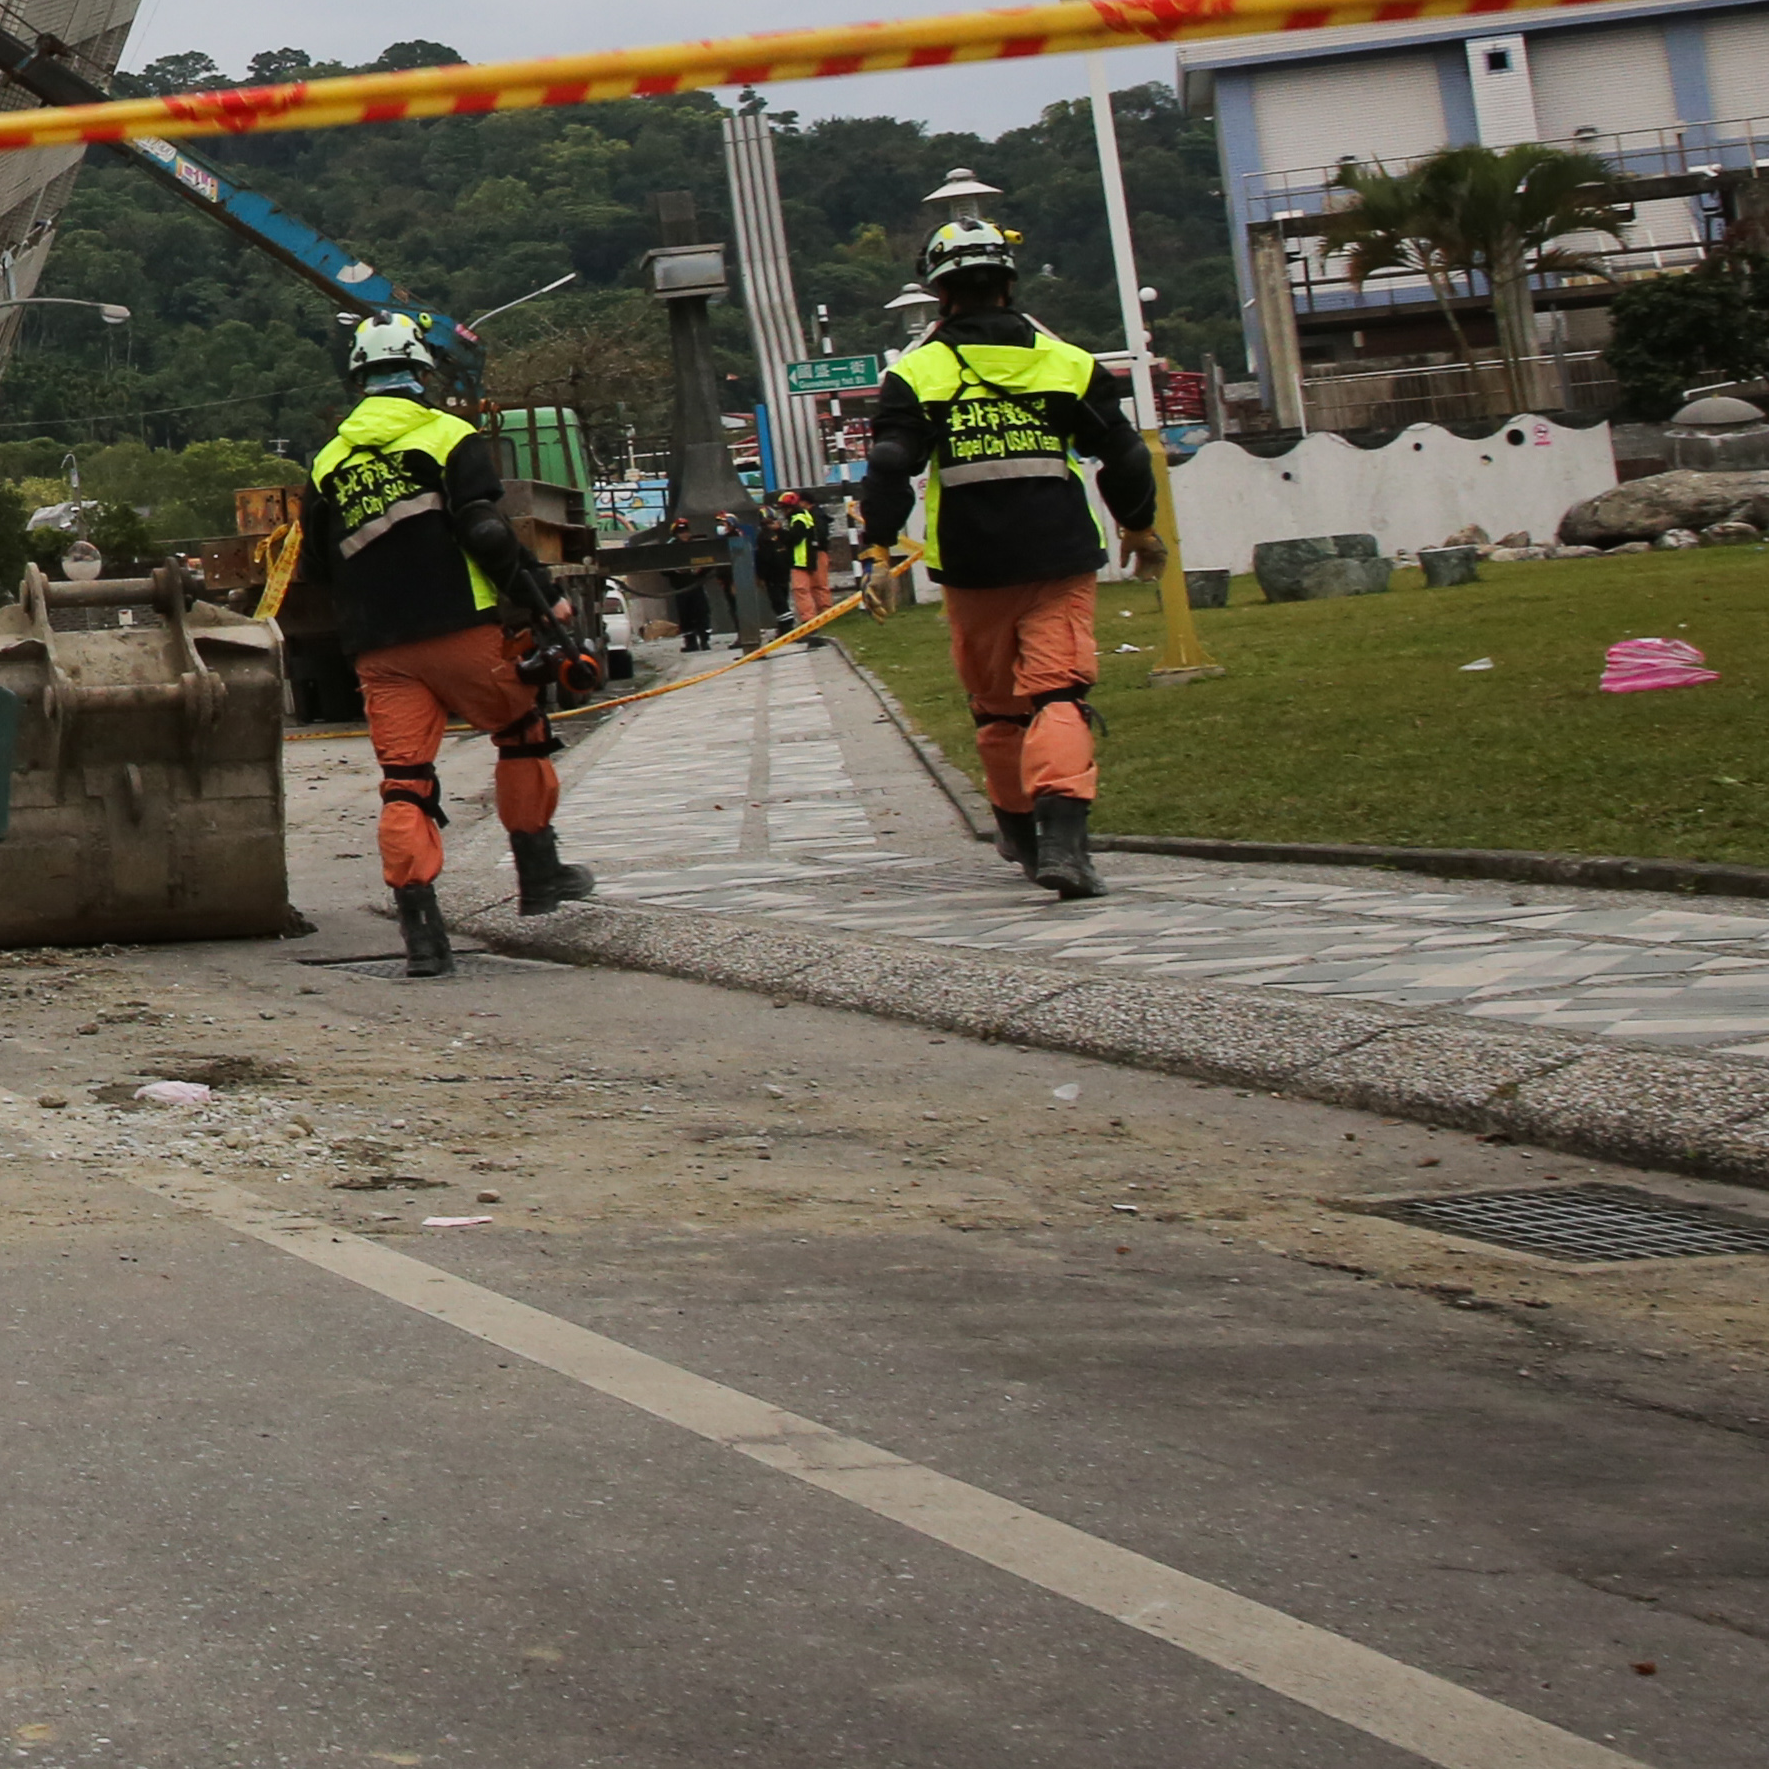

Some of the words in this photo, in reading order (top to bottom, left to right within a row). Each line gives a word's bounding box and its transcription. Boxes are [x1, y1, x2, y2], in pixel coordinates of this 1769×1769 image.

[948, 434, 983, 461] Taipei
[984, 434, 1006, 457] City
[1004, 429, 1038, 451] USAR
[1034, 430, 1063, 452] Team
